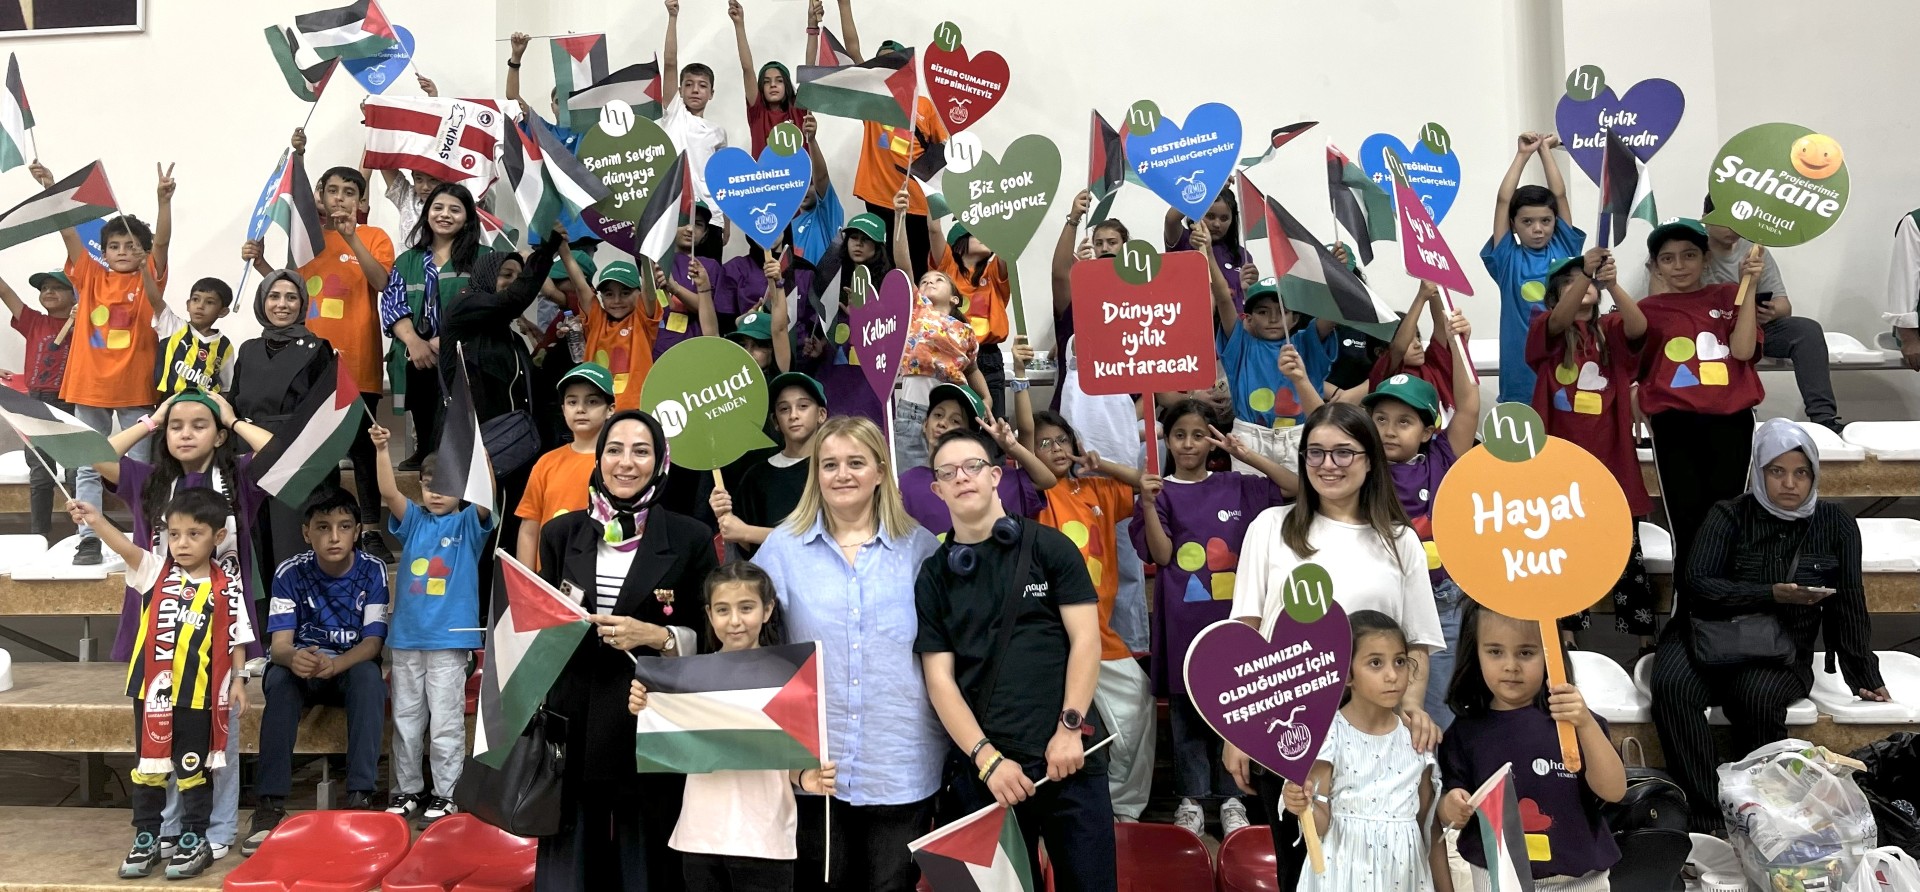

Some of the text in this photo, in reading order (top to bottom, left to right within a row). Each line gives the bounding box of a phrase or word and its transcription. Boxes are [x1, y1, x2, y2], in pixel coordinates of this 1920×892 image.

[931, 63, 1001, 91] BİZ HER CUMARTESİ
[935, 76, 993, 99] HEP BİRLİKTEYİZ
[1598, 108, 1638, 132] İyilik
[438, 127, 458, 160] KİPAŞ
[1150, 132, 1217, 155] DESTEĞİNİZLE
[1572, 130, 1659, 149] bulacıdır
[583, 144, 665, 172] Benim sevgim
[602, 167, 655, 187] dünyaya
[728, 168, 790, 184] DESTEĞİNİZLE
[969, 171, 1033, 200] Biz çook
[1714, 155, 1840, 218] Şahane
[1778, 170, 1840, 199] Projelerimiz
[614, 187, 649, 209] yeter
[961, 192, 1047, 225] eğleniyoruz
[602, 220, 635, 234] TEŞEKK
[1405, 206, 1424, 243] İyi
[1753, 206, 1796, 231] hayat
[1102, 301, 1182, 327] Dünyayı
[862, 315, 897, 347] Kalbini
[1121, 326, 1166, 356] iyilik
[875, 353, 887, 373] aç
[1094, 355, 1199, 379] kurtaracak
[682, 364, 754, 412] hayat
[1471, 481, 1586, 540] Hayal
[1502, 547, 1568, 582] kur
[1233, 640, 1313, 678] YANIMIZDA
[1218, 651, 1336, 705] OLDUĞUNUZ İÇİN
[1222, 670, 1340, 725] TEŞEKKÜR EDERİZ
